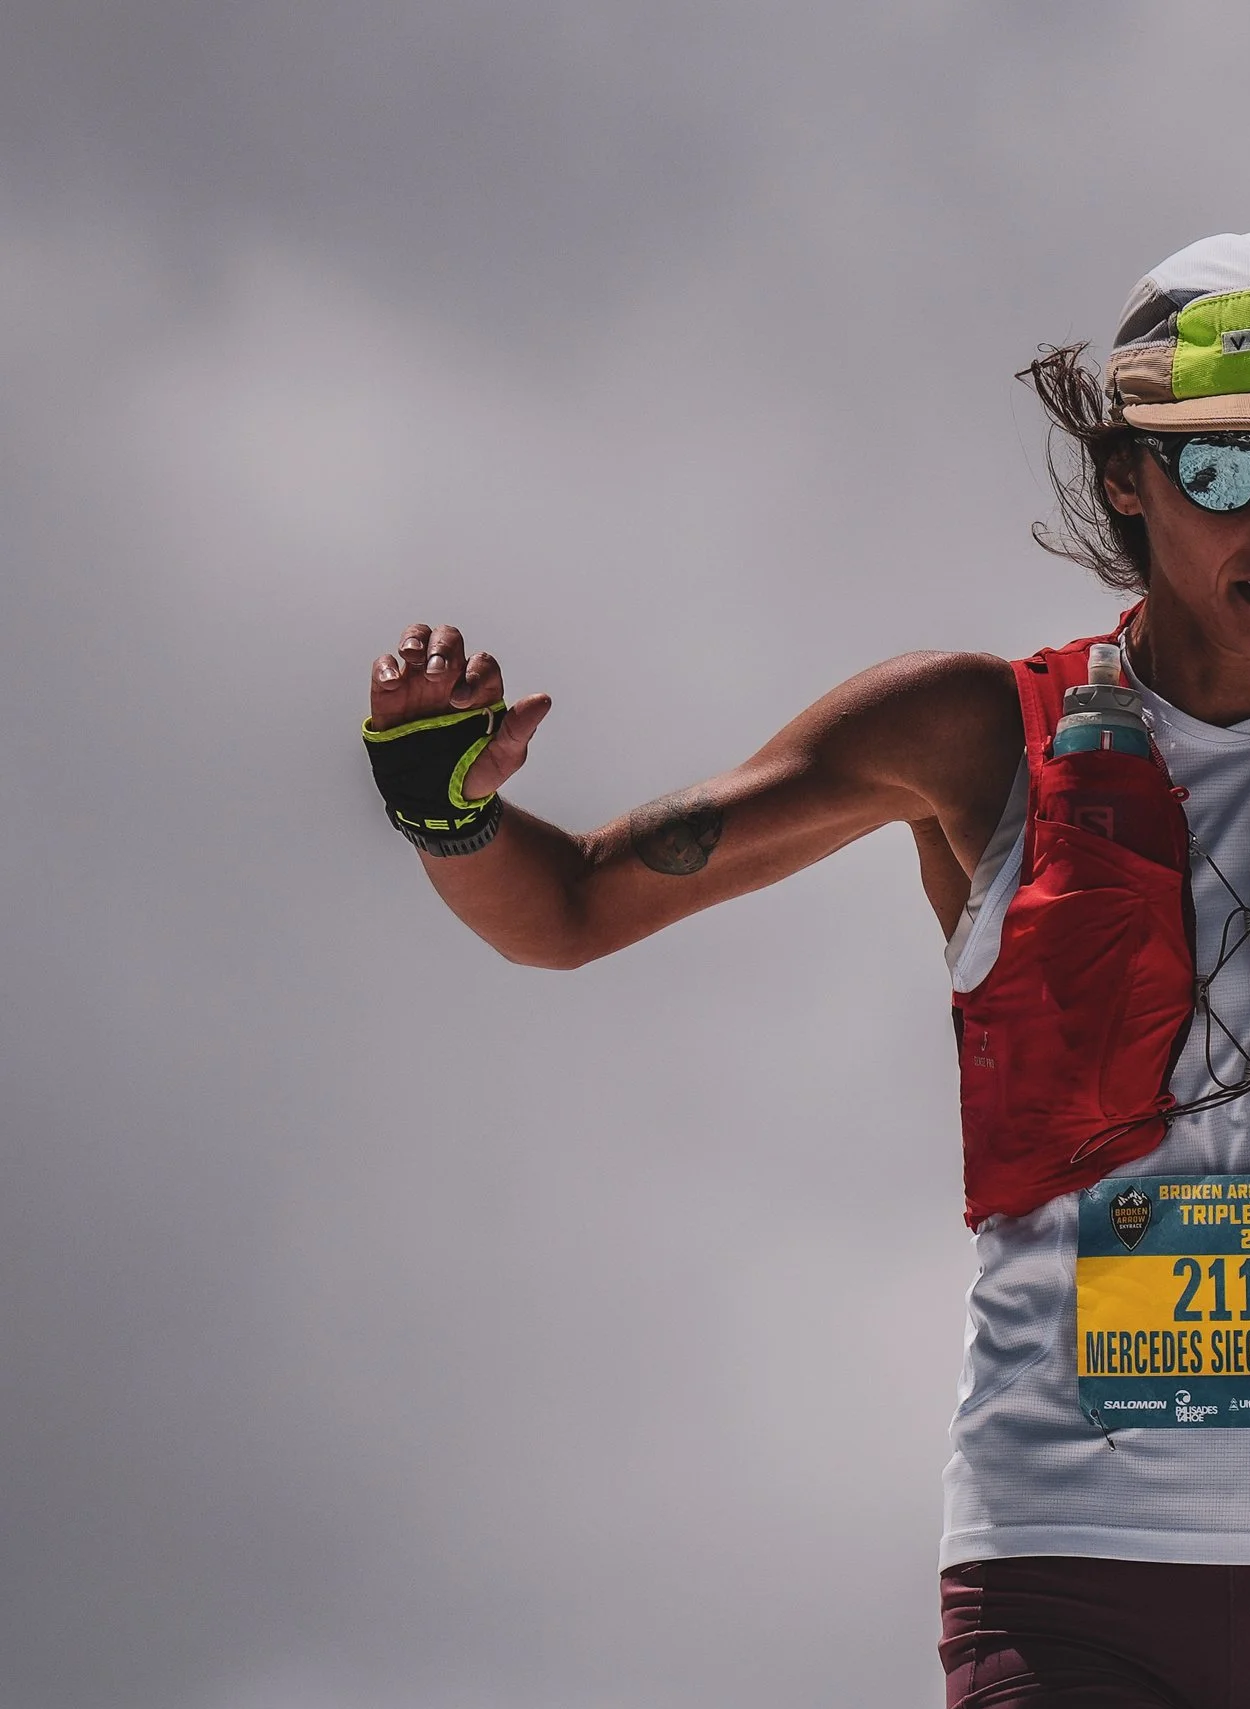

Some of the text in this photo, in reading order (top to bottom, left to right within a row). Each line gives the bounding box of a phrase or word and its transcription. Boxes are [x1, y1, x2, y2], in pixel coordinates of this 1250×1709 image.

[1159, 1184, 1223, 1200] BROKEN
[1115, 1207, 1148, 1217] BROKEN
[1117, 1216, 1146, 1224] ARROW
[1086, 1329, 1203, 1374] MERCEDES
[1103, 1400, 1167, 1410] SALOMON
[1175, 1405, 1218, 1416] PALISADES
[1177, 1413, 1204, 1422] TAHOE
